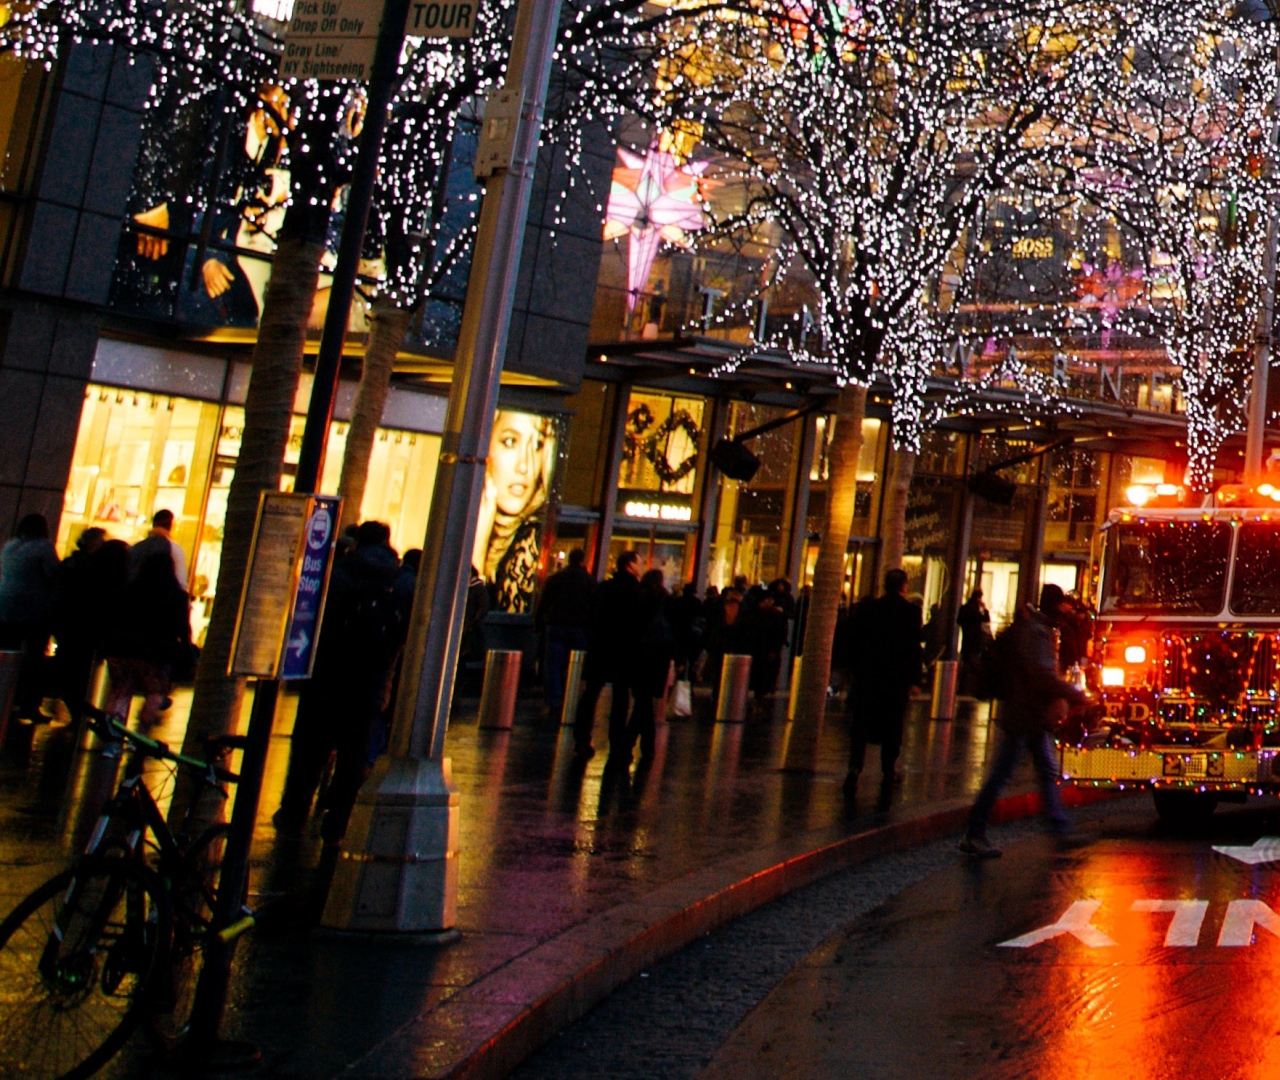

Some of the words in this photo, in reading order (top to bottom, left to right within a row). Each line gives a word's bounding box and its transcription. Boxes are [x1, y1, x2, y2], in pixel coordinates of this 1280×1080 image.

[296, 2, 319, 14] Pick
[413, 3, 472, 29] TOUR
[292, 19, 317, 34] Drop
[321, 19, 337, 32] Off
[340, 19, 364, 34] Only
[287, 44, 312, 58] Gray
[284, 62, 299, 74] NY
[302, 62, 365, 77] Sightseeing
[304, 554, 323, 572] Bus
[299, 576, 321, 594] Stop
